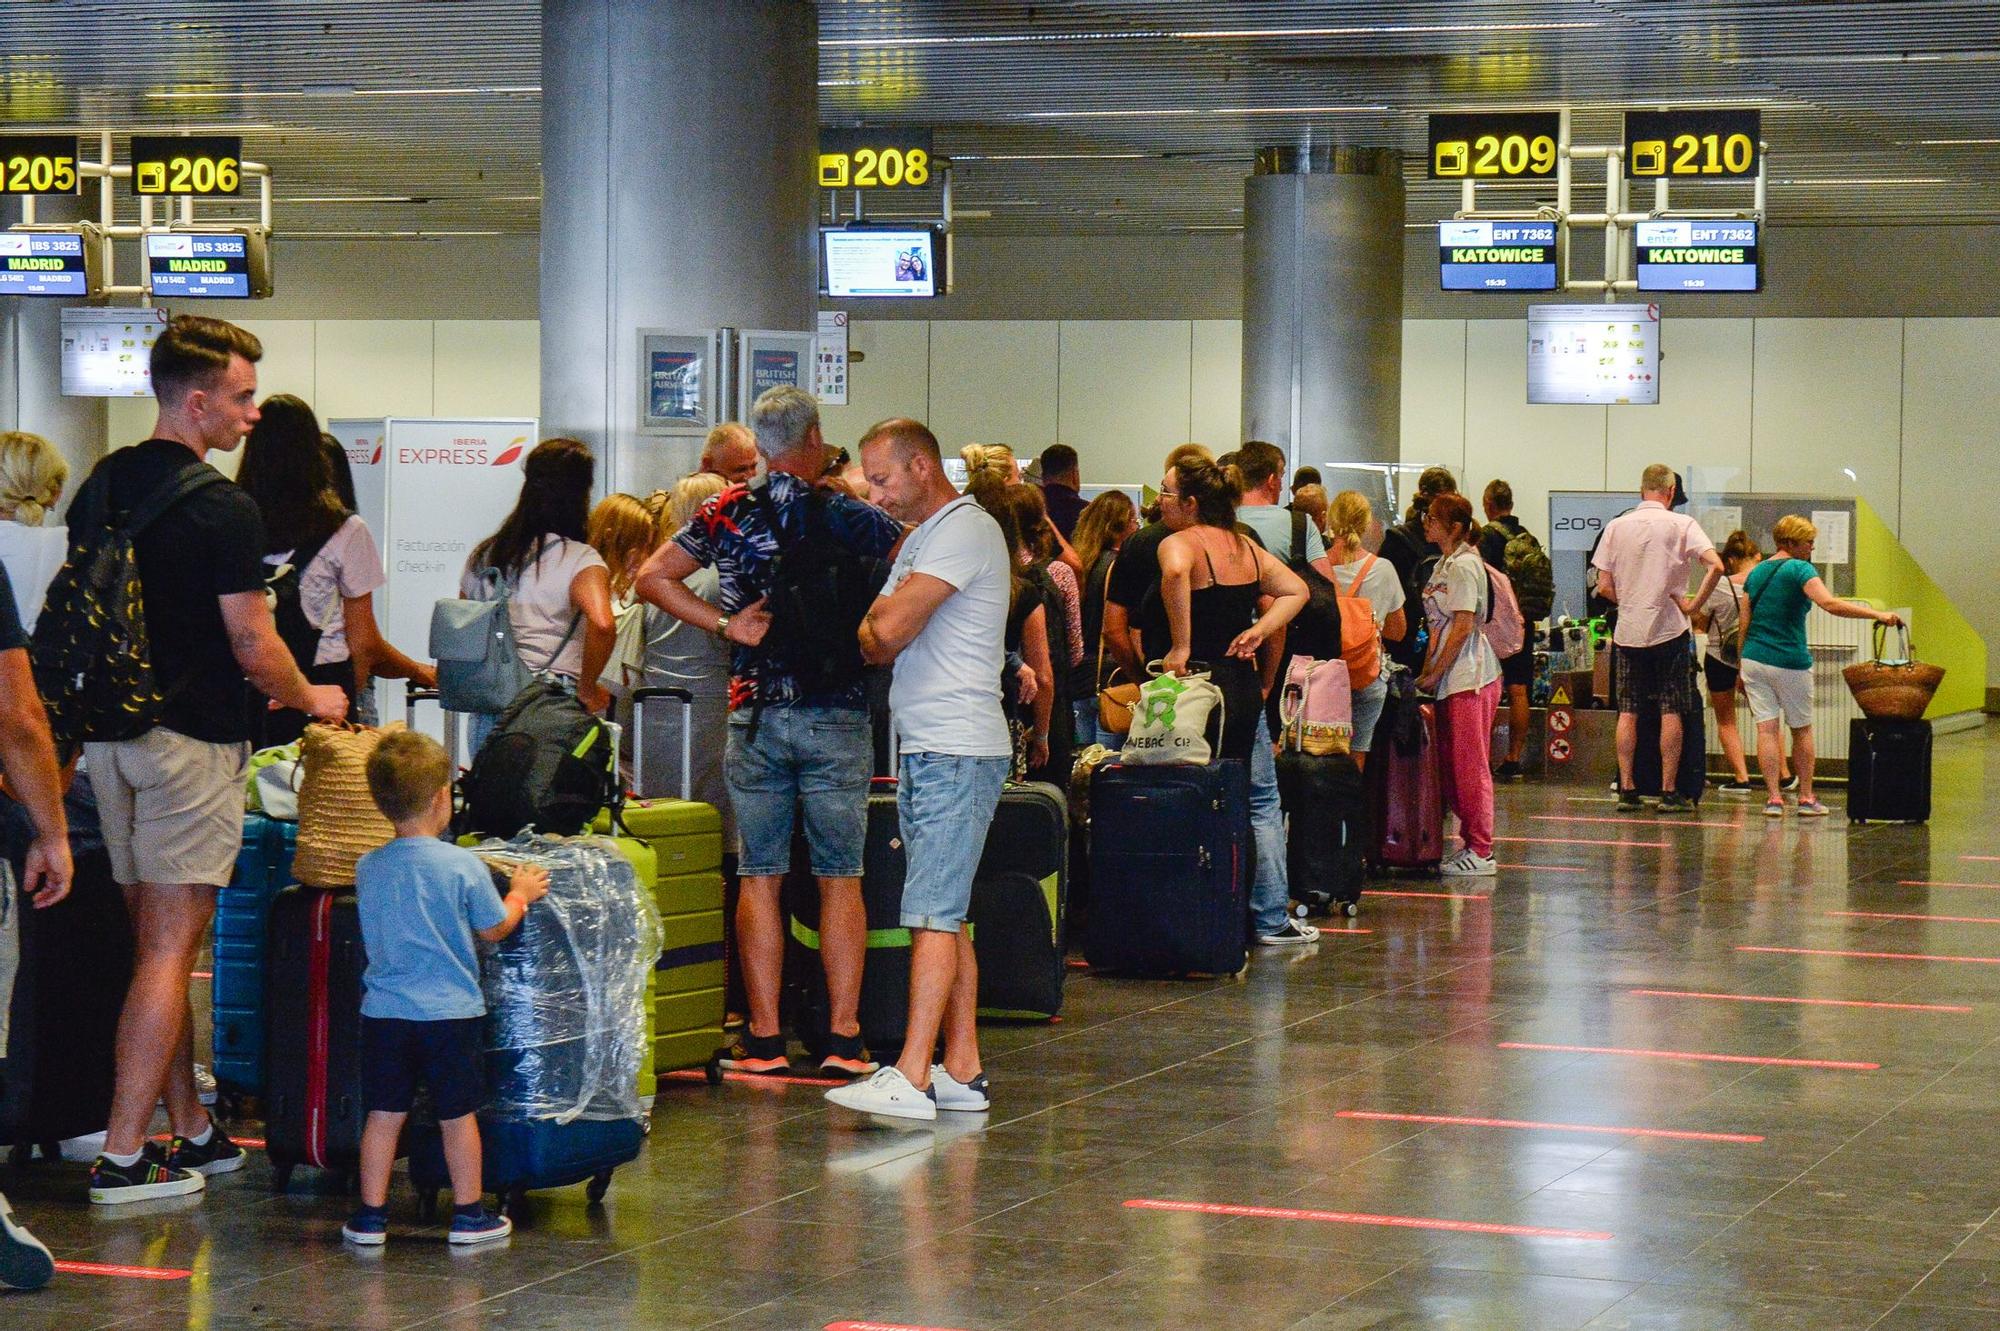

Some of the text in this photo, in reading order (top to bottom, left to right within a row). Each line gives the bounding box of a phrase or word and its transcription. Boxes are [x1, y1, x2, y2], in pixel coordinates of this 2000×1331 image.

[1474, 135, 1556, 174] 209
[1672, 133, 1753, 173] 210
[8, 156, 76, 191] 205
[854, 148, 928, 186] 208
[169, 157, 239, 192] 206
[1493, 229, 1553, 240] ENT 7362
[1647, 234, 1678, 244] enter
[1692, 229, 1753, 241] ENT 7362
[31, 241, 79, 251] IBS 3825
[193, 242, 243, 252] IBS 3825
[1452, 248, 1544, 263] KATOWICE
[1649, 248, 1744, 263] KATOWICE
[8, 258, 65, 271] MADRID
[169, 259, 227, 272] MADRID
[38, 275, 72, 283] MADRID
[200, 276, 234, 285] MADRID
[755, 369, 796, 378] BRITISH
[453, 438, 487, 446] IBERIA
[399, 448, 488, 465] EXPRESS
[1555, 517, 1601, 530] 209
[397, 538, 466, 552] Facturación
[397, 559, 446, 573] Check-in
[1174, 737, 1191, 747] CI?
